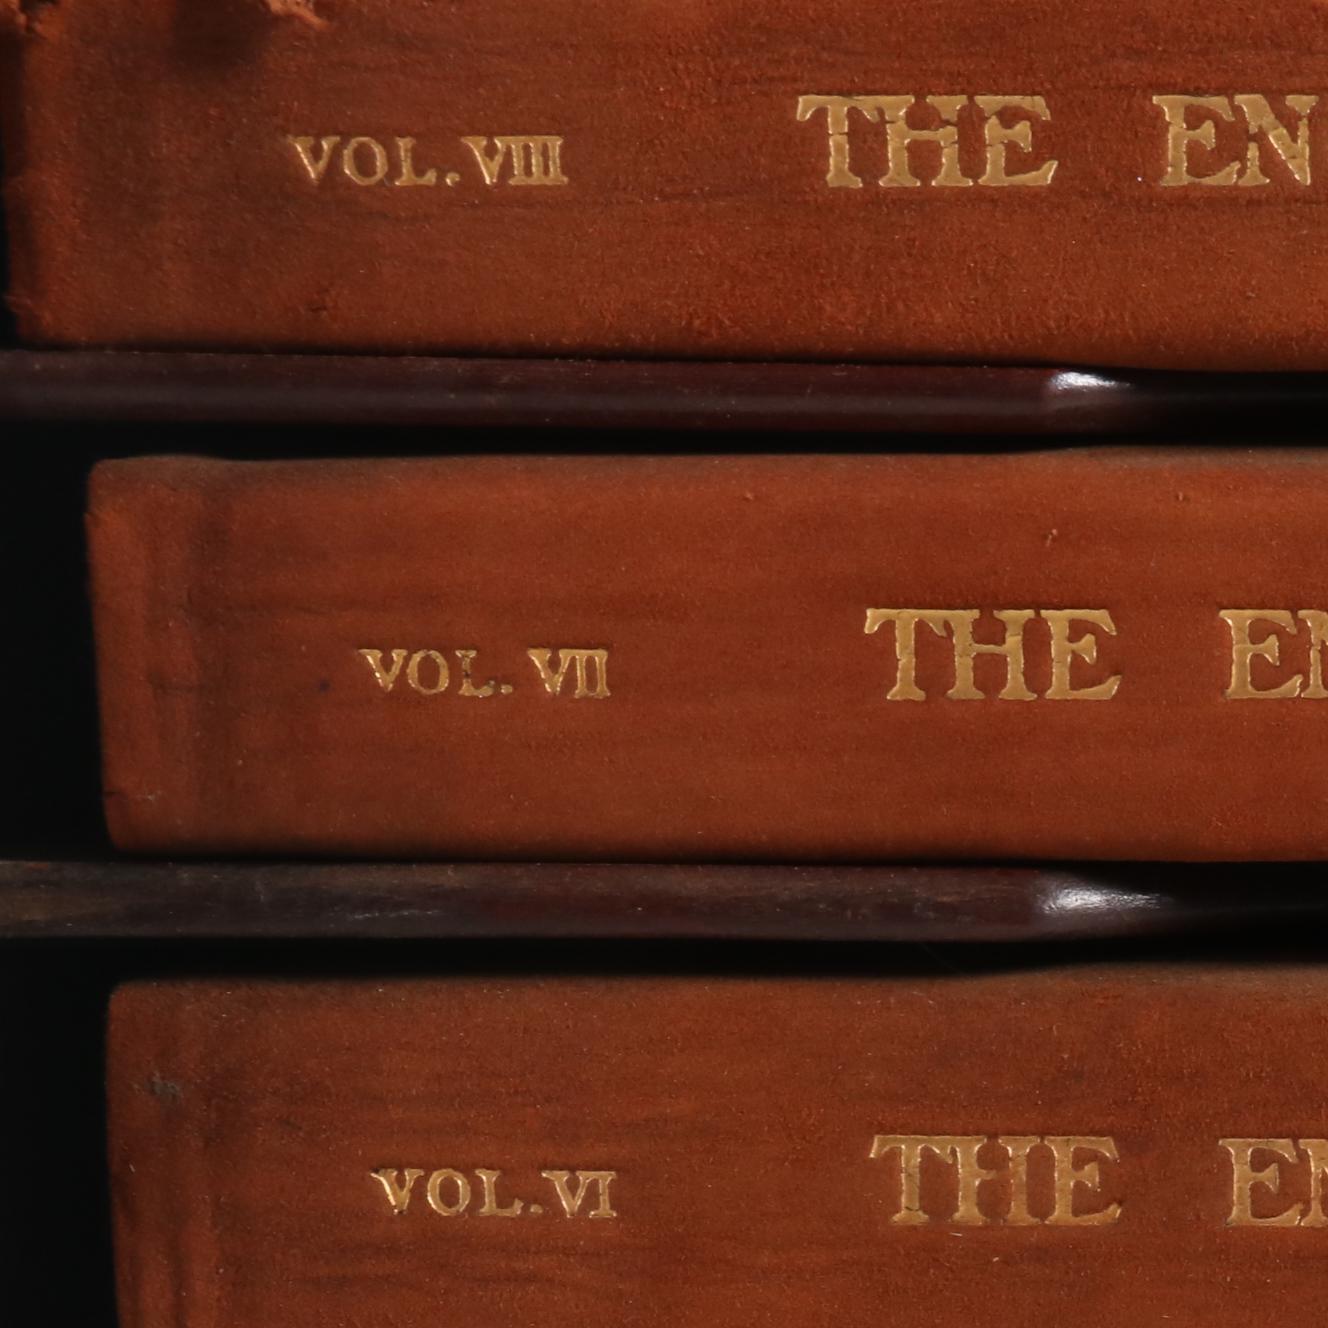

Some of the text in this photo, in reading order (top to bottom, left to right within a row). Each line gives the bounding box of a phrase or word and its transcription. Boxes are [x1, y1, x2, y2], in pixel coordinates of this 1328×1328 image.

[796, 95, 1058, 188] THE
[864, 608, 1121, 700] THE
[869, 1135, 1121, 1227] THE
